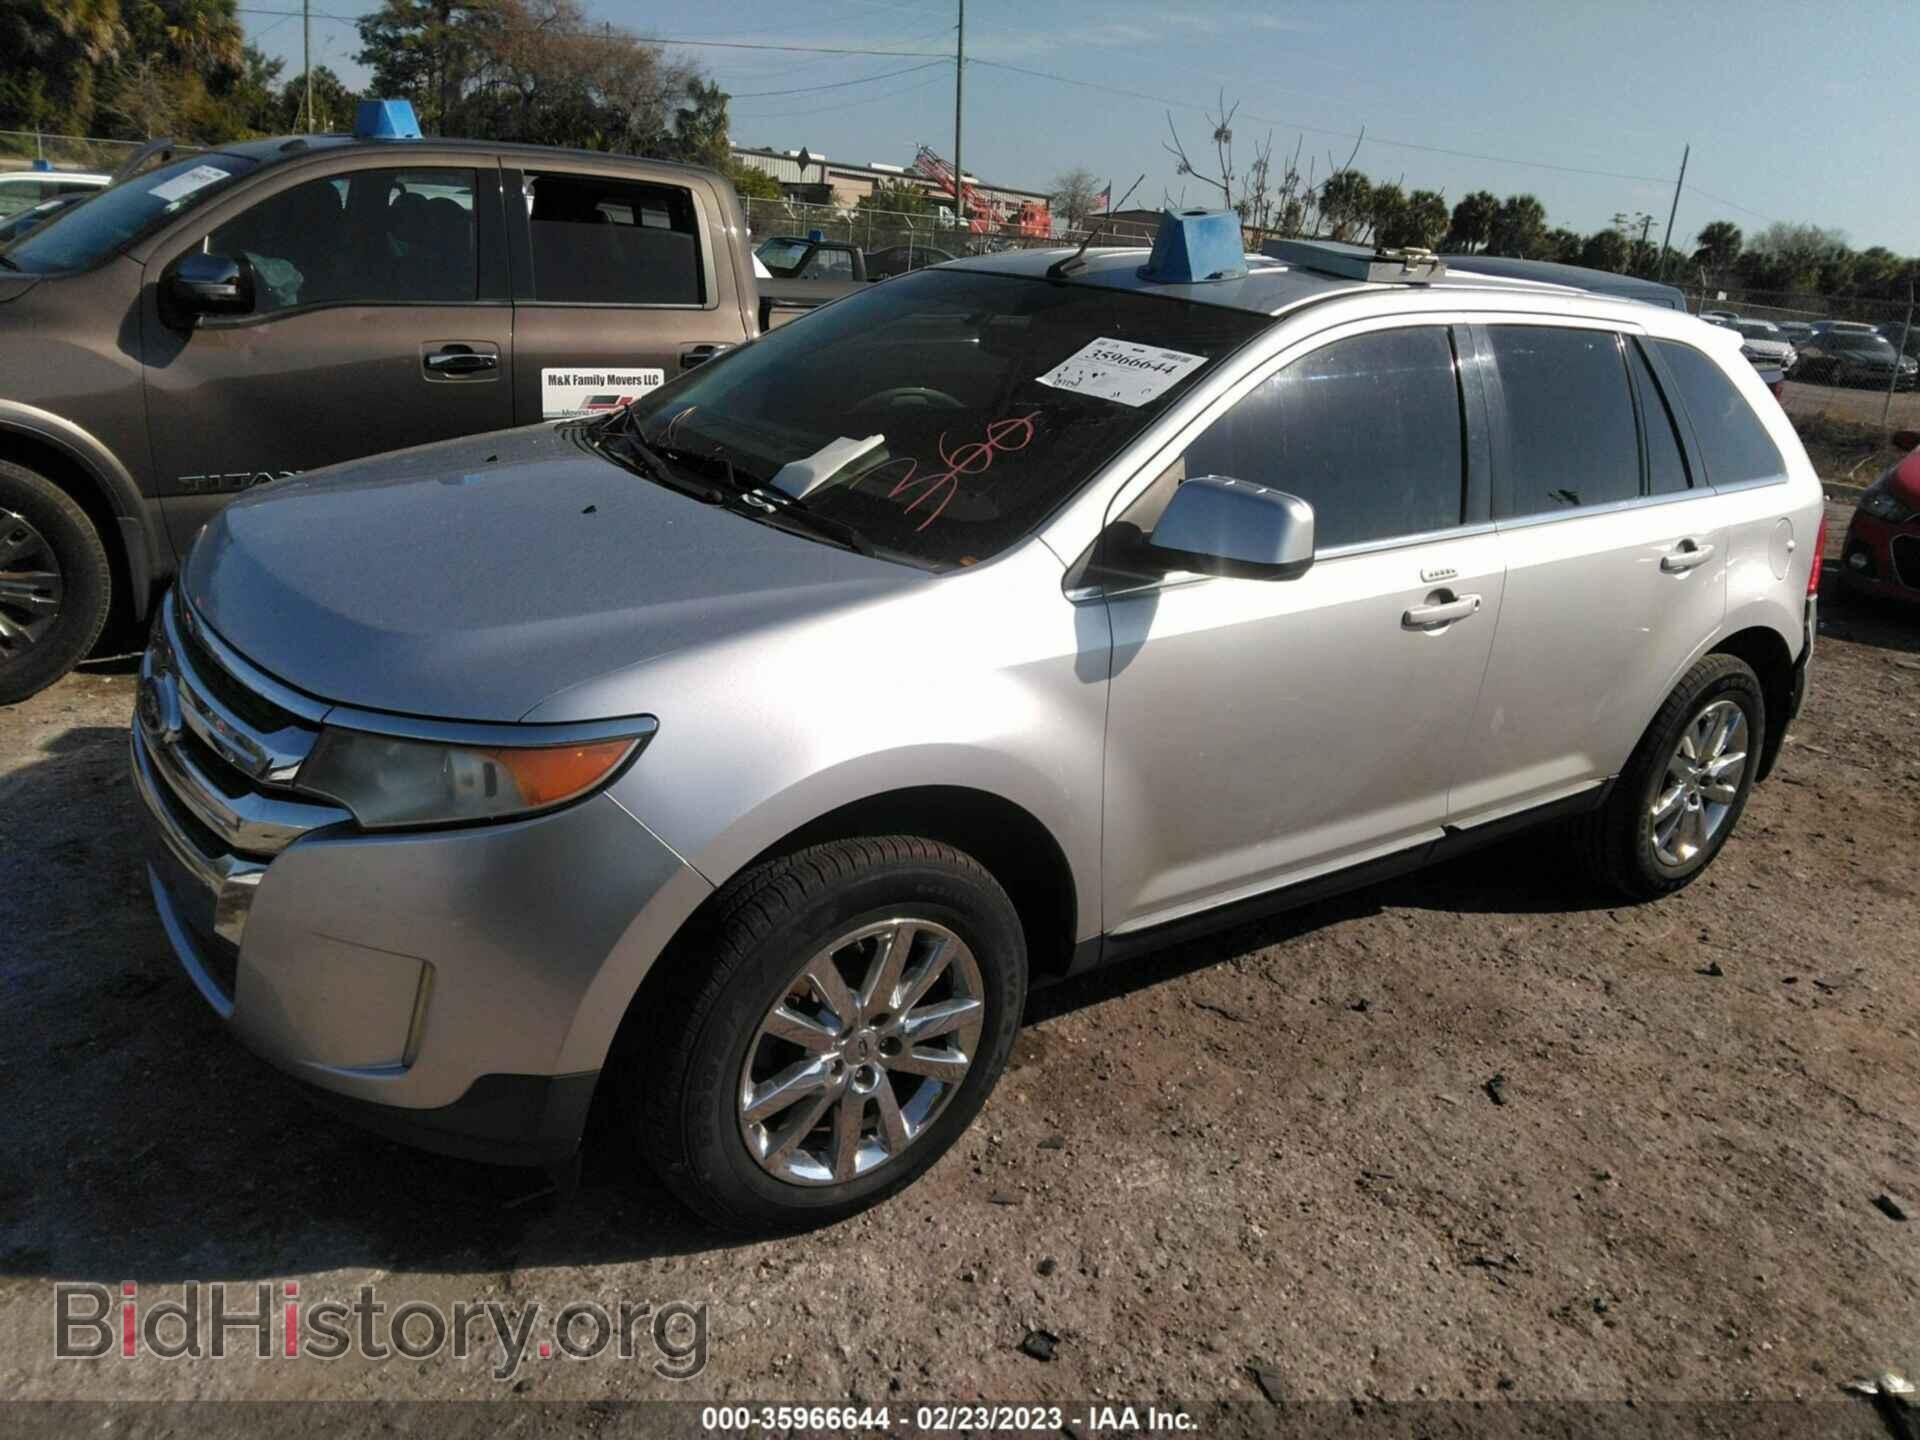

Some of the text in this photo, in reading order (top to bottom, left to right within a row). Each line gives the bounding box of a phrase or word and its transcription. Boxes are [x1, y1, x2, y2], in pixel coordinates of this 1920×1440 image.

[1085, 349, 1179, 375] 35966644
[547, 374, 659, 387] M&K Family Movers LLC
